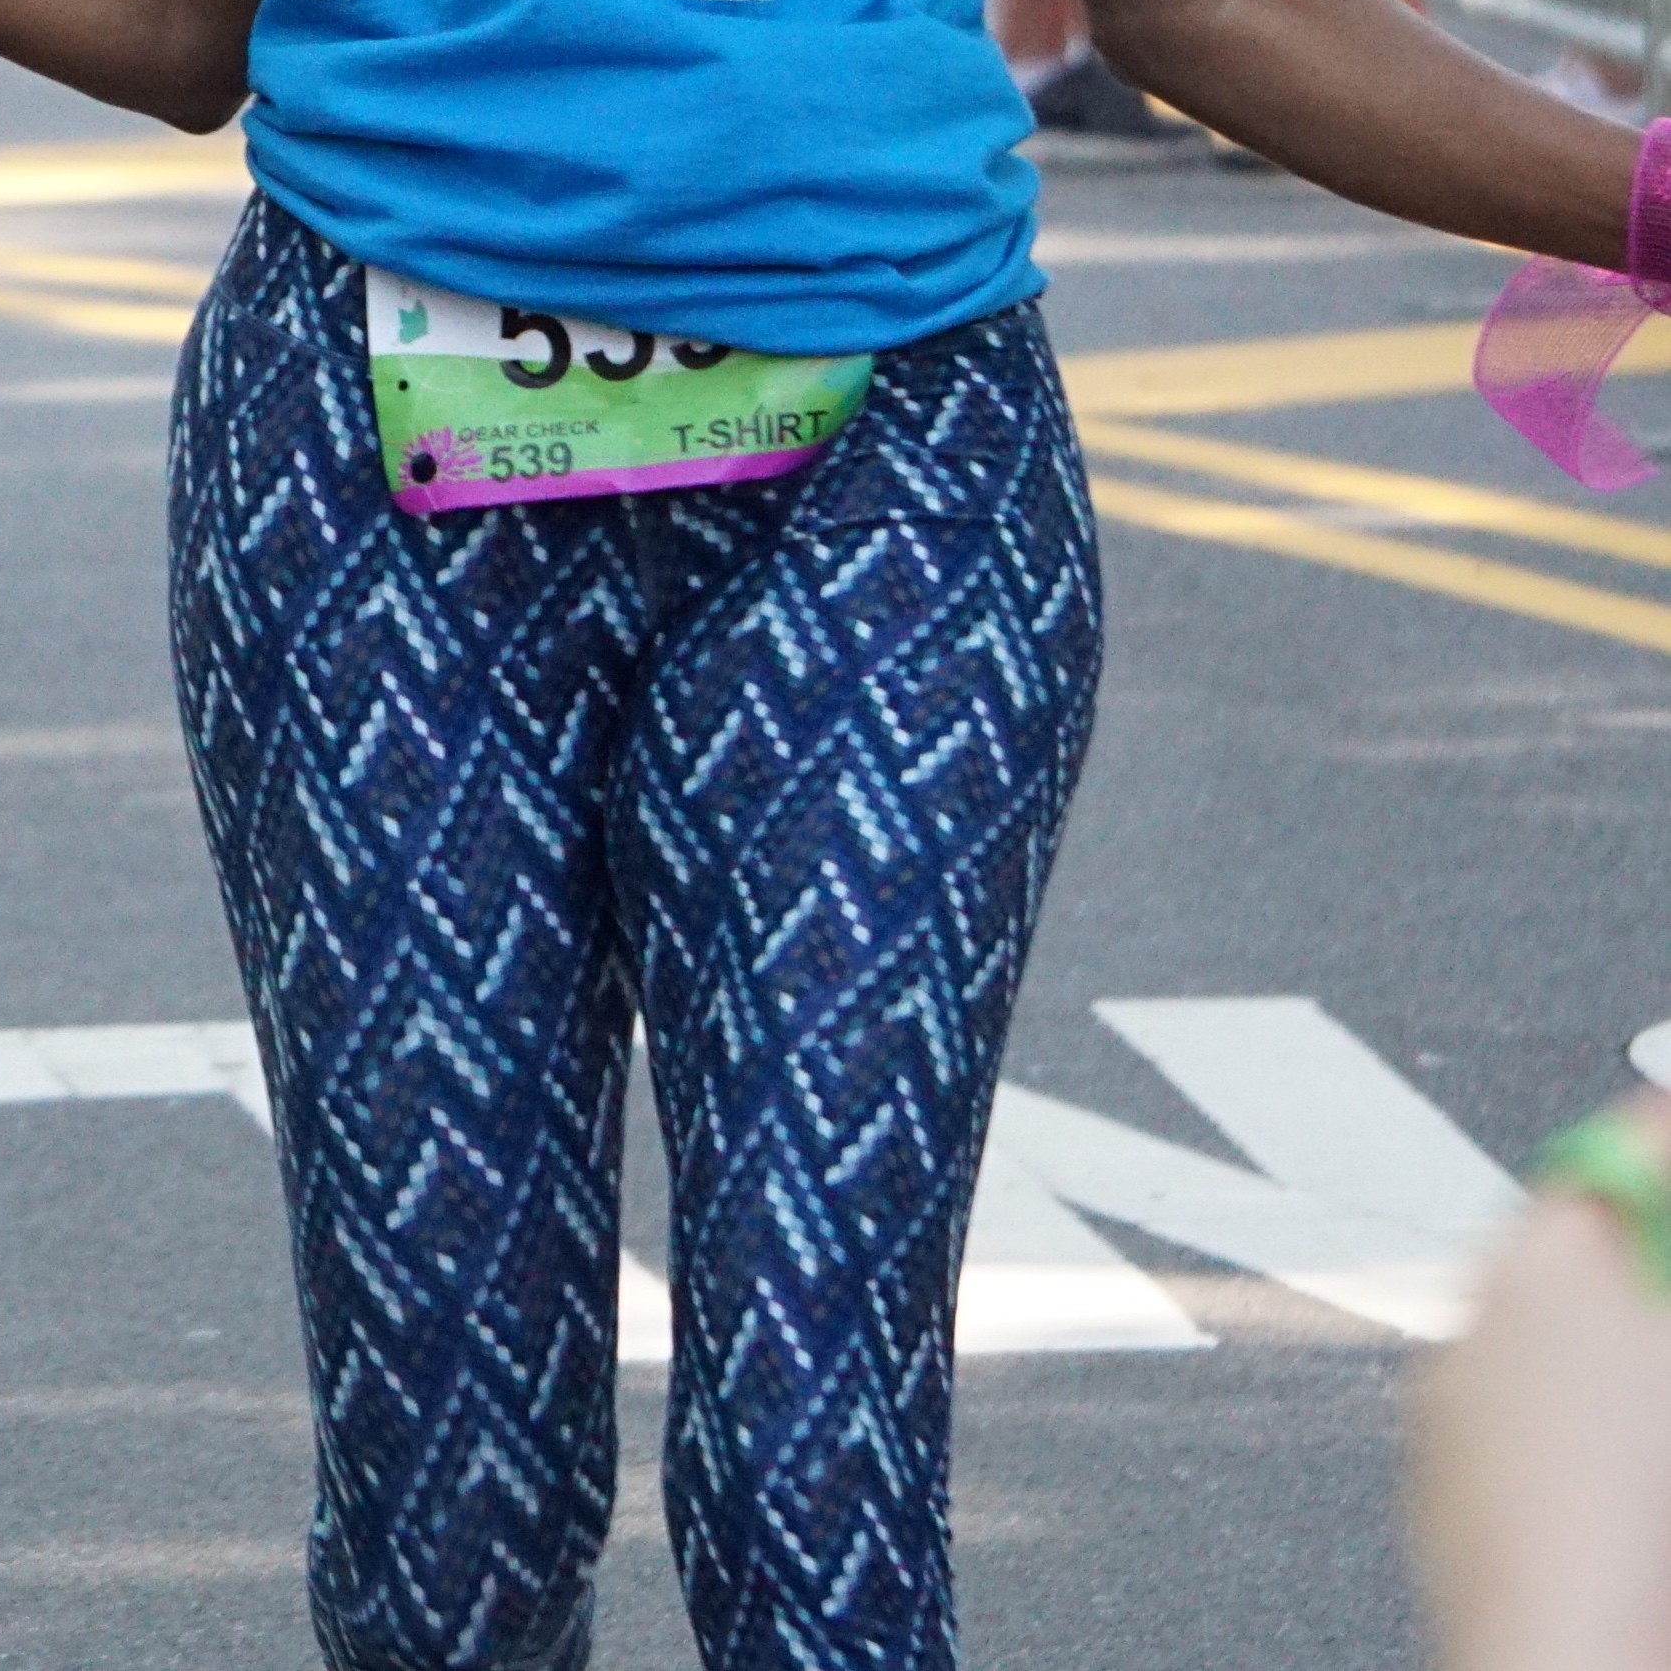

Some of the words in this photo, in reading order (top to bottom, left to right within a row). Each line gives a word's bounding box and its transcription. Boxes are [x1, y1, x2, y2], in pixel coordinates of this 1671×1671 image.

[526, 419, 600, 438] CHECK
[670, 409, 831, 454] T-SHIRT
[490, 441, 573, 484] 539
